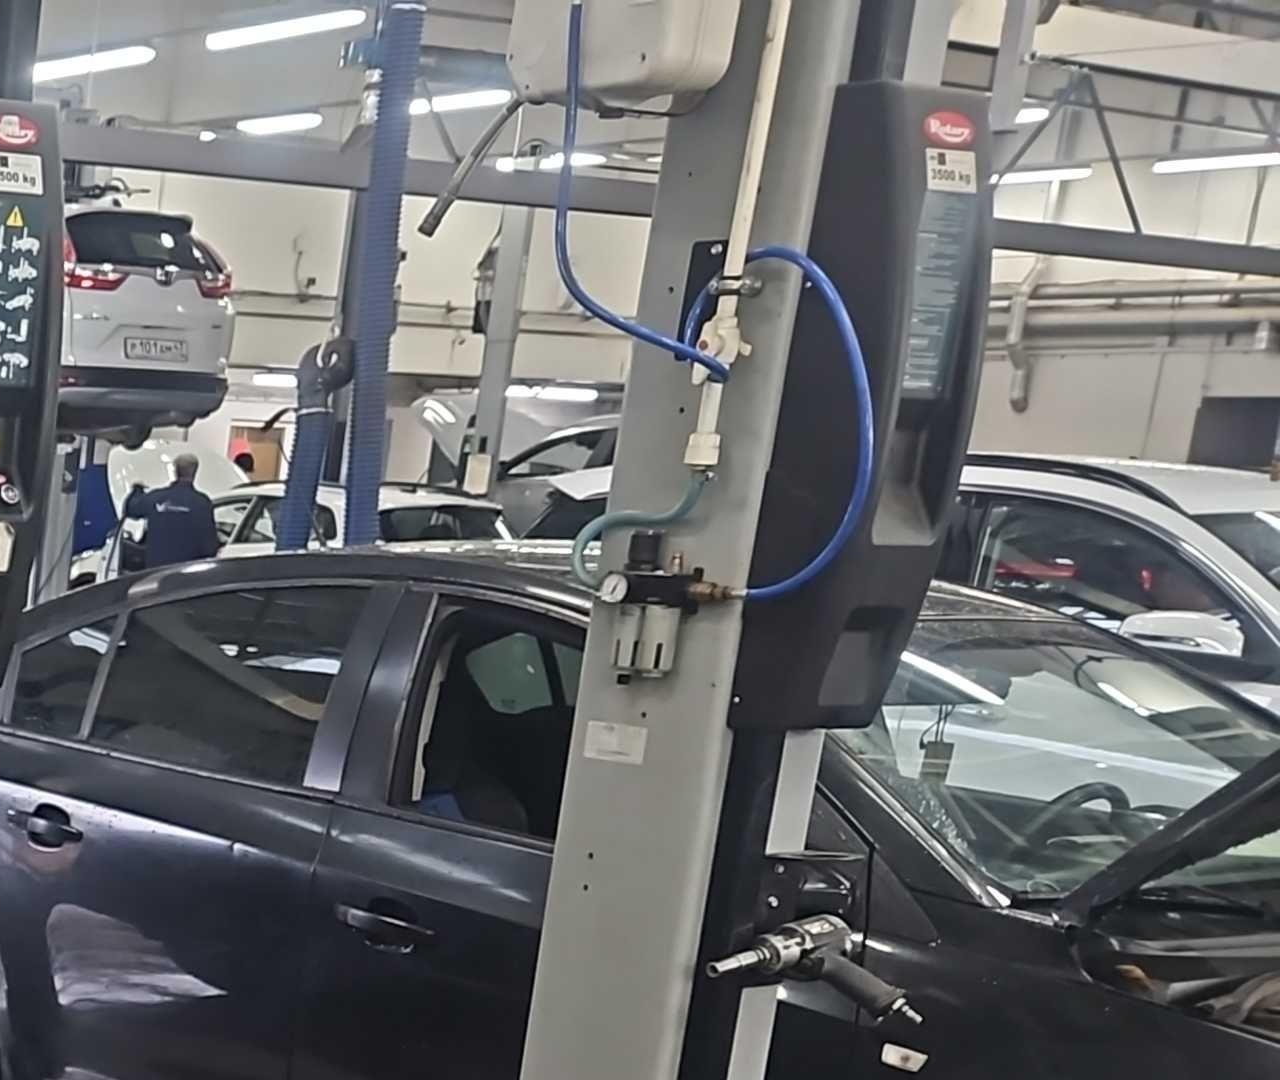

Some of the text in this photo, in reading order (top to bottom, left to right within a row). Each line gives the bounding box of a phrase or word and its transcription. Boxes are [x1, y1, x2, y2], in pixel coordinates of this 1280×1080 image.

[22, 172, 37, 187] kg
[930, 167, 971, 185] 3500 kg
